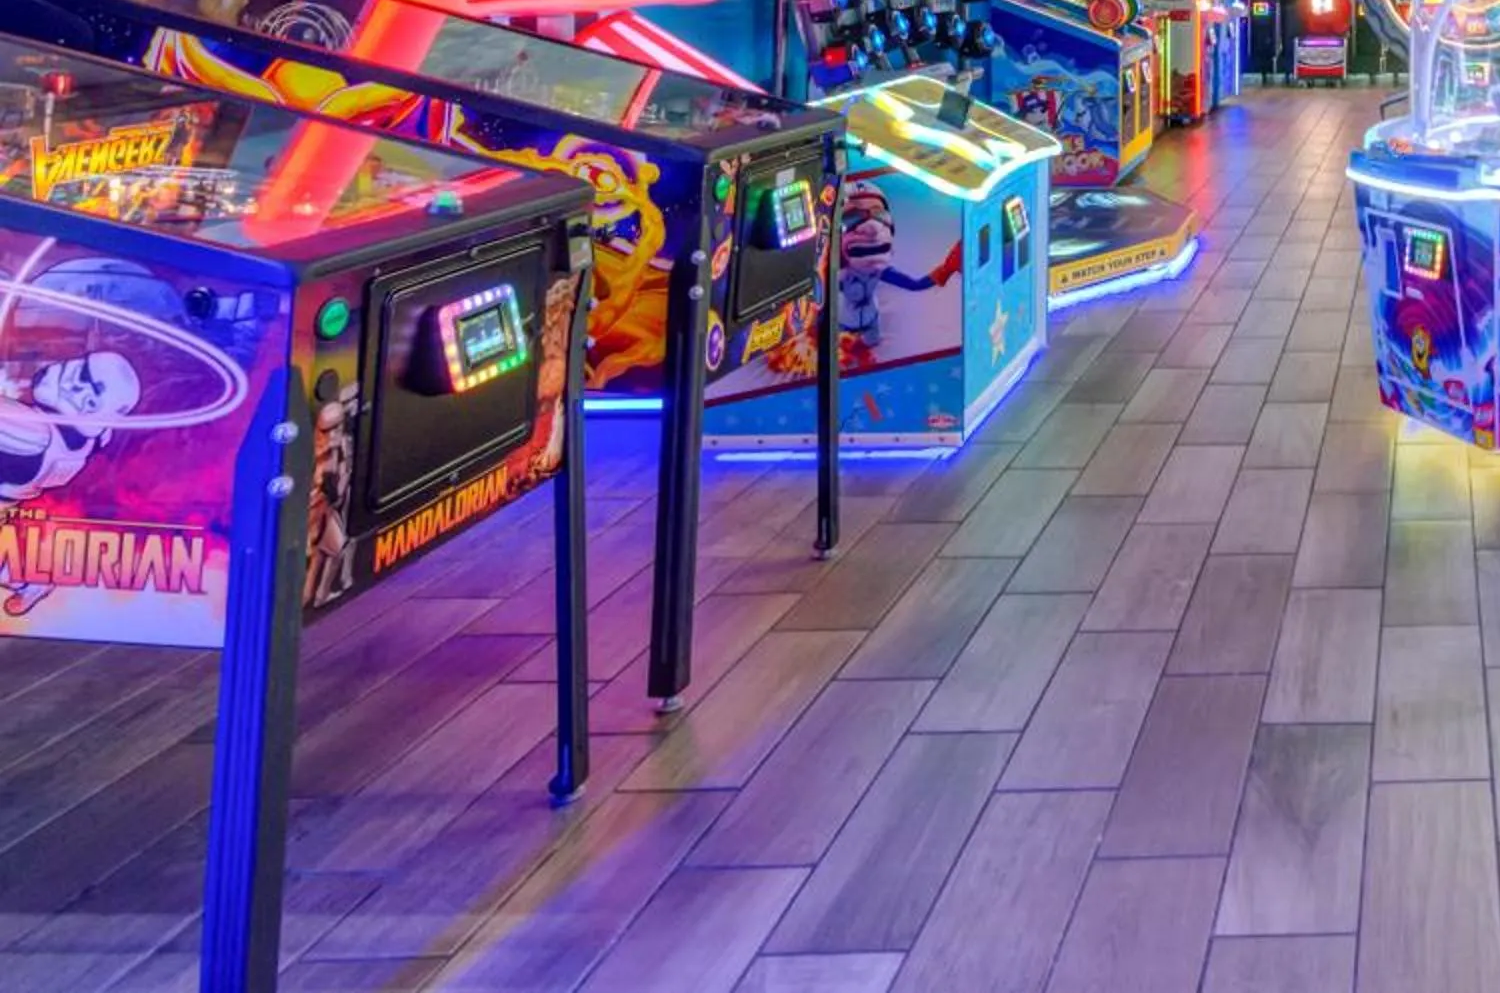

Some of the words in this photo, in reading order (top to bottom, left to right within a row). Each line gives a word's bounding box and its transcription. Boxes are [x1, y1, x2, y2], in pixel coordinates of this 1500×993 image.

[1071, 264, 1105, 280] WATCH
[1108, 255, 1133, 270] YOUR
[1135, 249, 1157, 265] STEP
[8, 508, 47, 520] THE
[373, 465, 508, 574] MANDALORIAN
